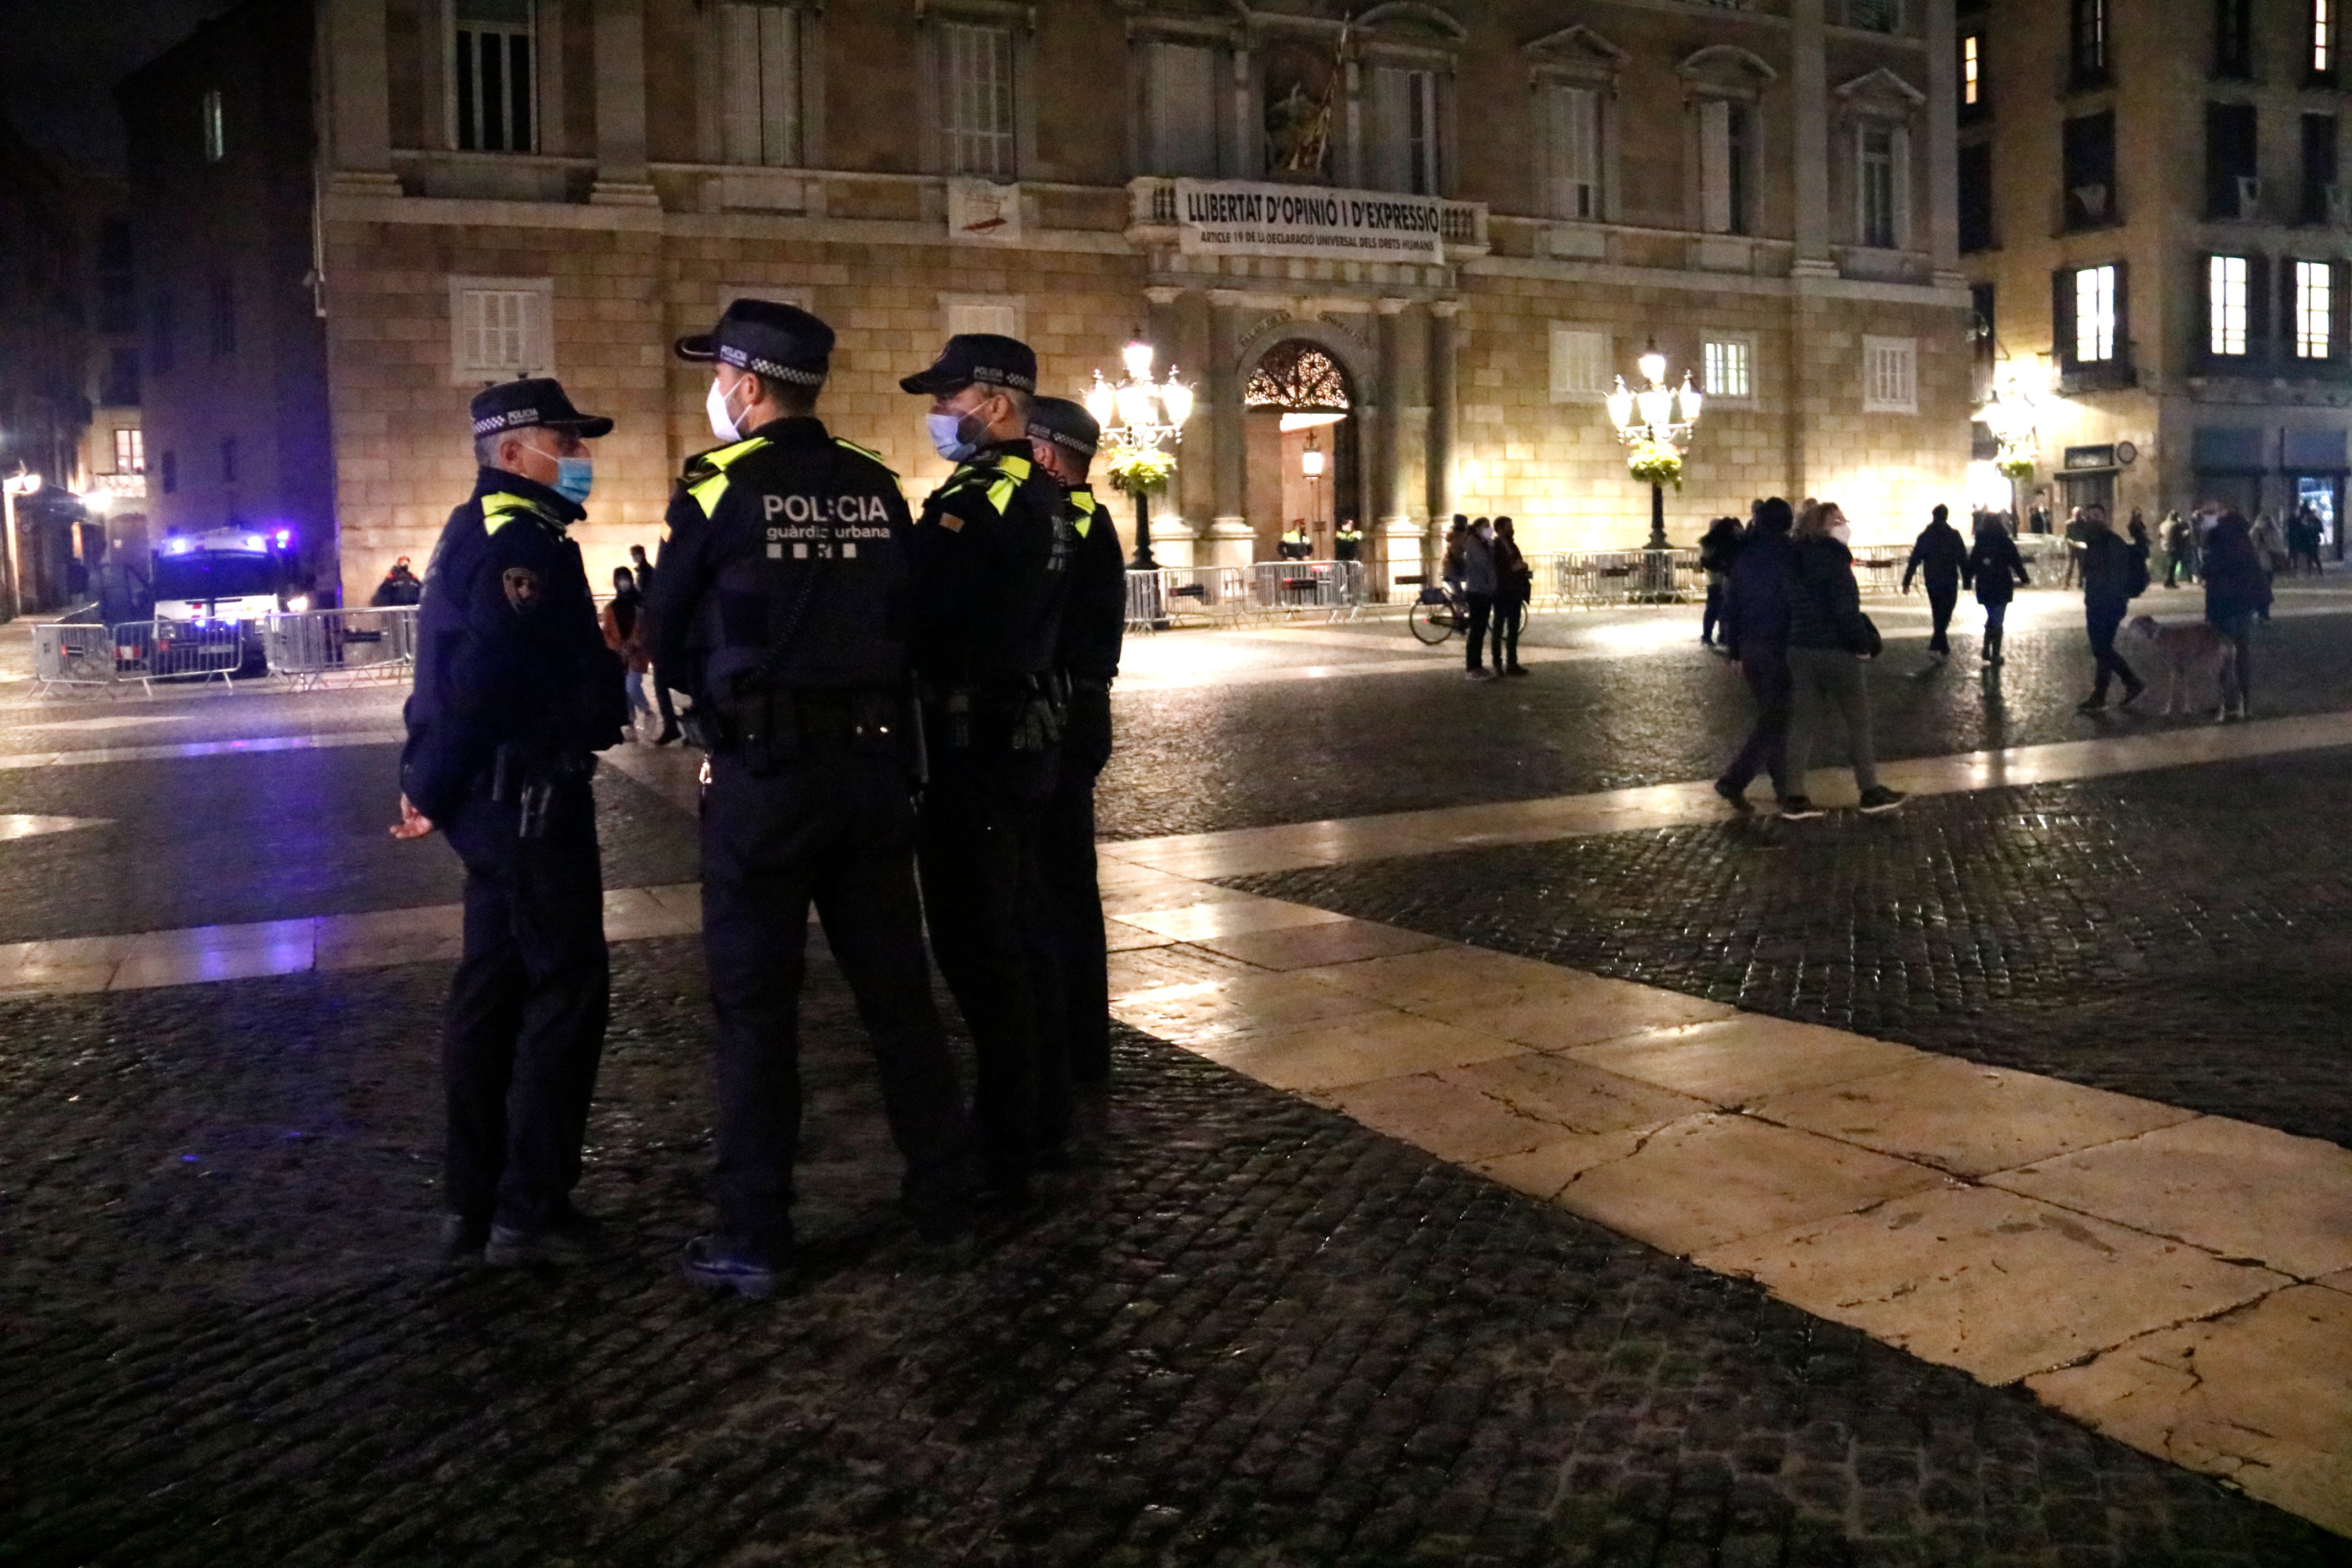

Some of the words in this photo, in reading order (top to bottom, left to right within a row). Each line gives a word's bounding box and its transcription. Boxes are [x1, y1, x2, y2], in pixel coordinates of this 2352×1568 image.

[1188, 193, 1262, 222] LLIBERTAT
[1267, 193, 1338, 226] D'OPINIÓ
[1342, 200, 1348, 226] I
[1201, 232, 1231, 243] ARTICLE
[1234, 232, 1243, 242] 19
[1246, 232, 1255, 242] DE
[1316, 235, 1357, 247] UNIVERSAL
[1360, 237, 1376, 248] DELS
[1379, 238, 1400, 249] DRETS
[1403, 240, 1434, 251] HUMANS
[835, 525, 891, 539] urbana
